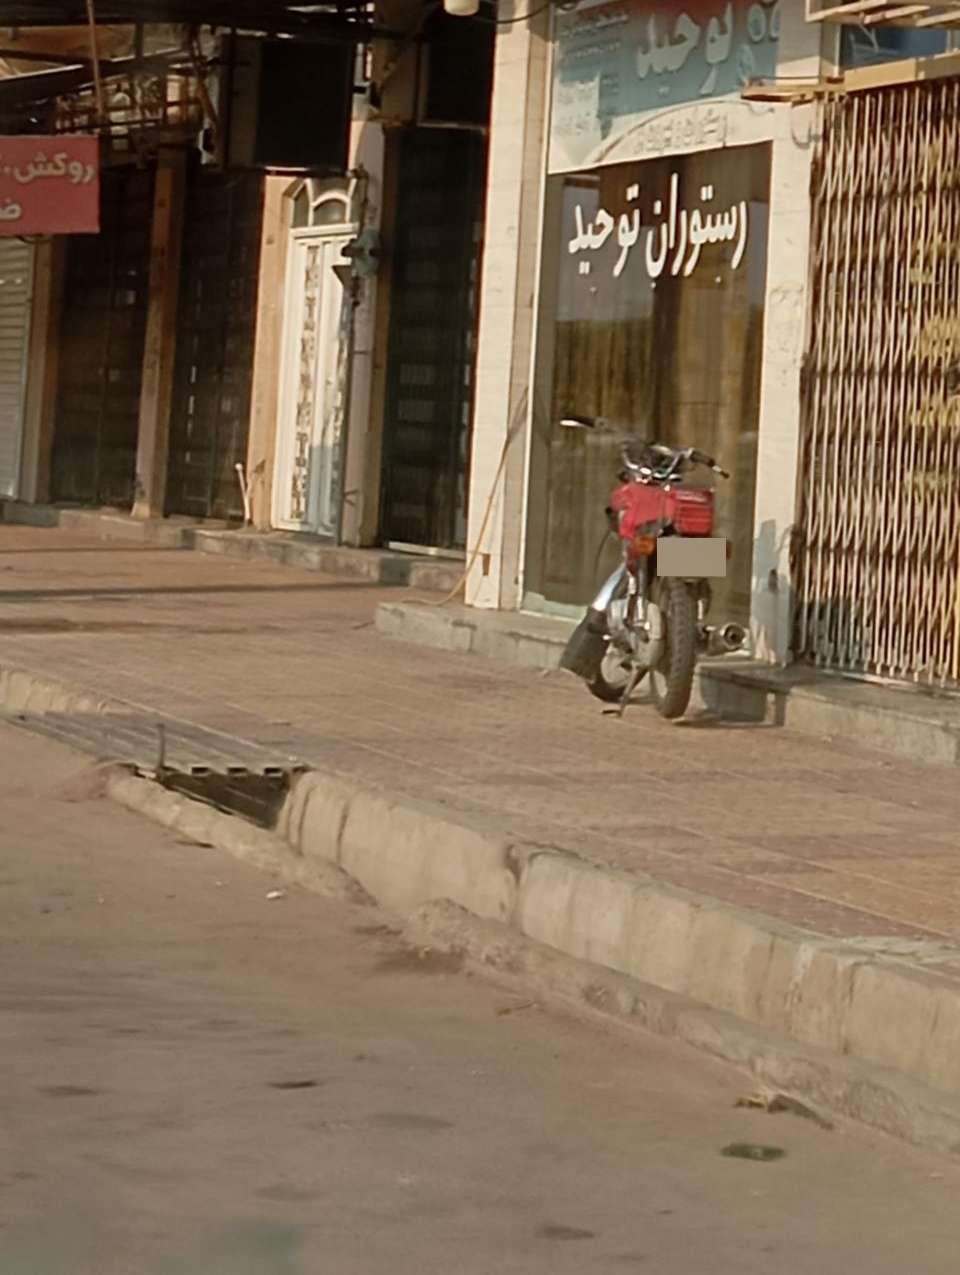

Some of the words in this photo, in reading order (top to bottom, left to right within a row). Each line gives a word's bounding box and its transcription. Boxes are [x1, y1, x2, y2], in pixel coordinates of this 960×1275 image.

[14, 151, 95, 184] روکش
[568, 183, 641, 277] توحید
[645, 172, 748, 278] رستوران
